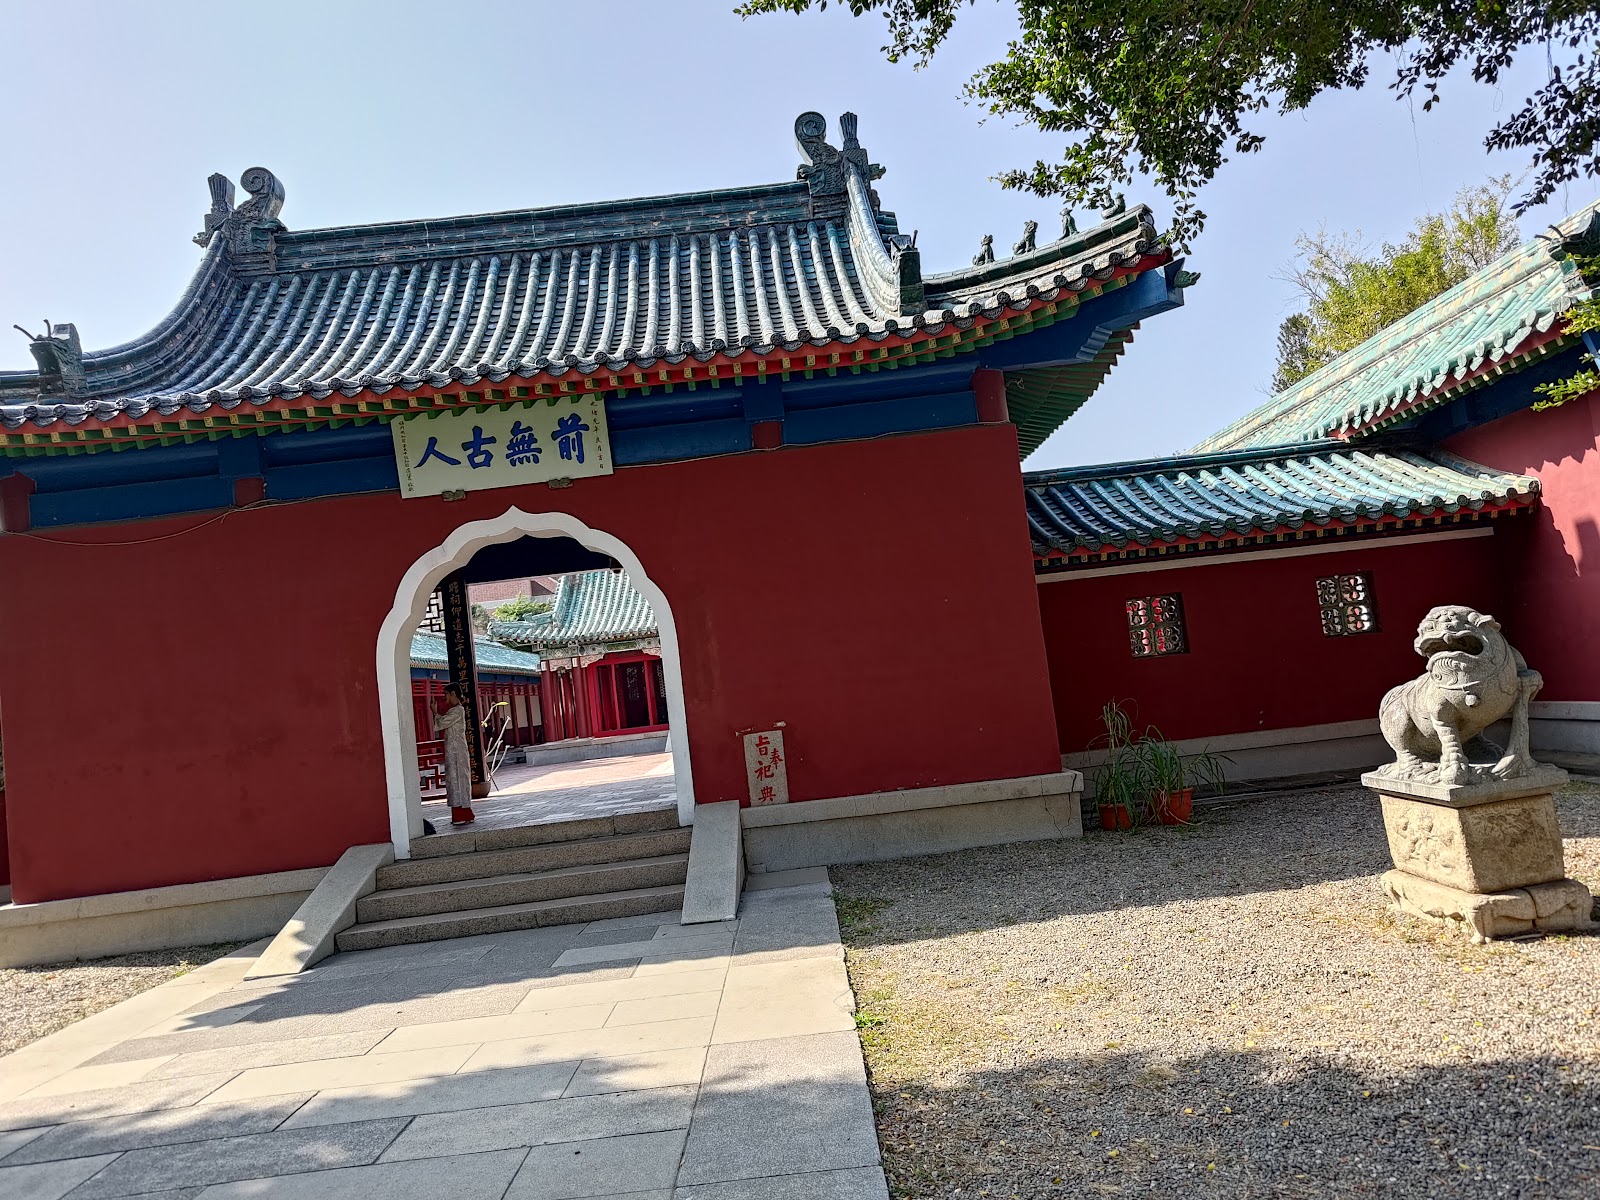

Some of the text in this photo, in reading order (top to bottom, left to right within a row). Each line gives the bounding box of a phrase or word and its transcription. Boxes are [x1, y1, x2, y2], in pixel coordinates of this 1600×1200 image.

[413, 412, 590, 470] 前無古人
[769, 748, 784, 770] 奉
